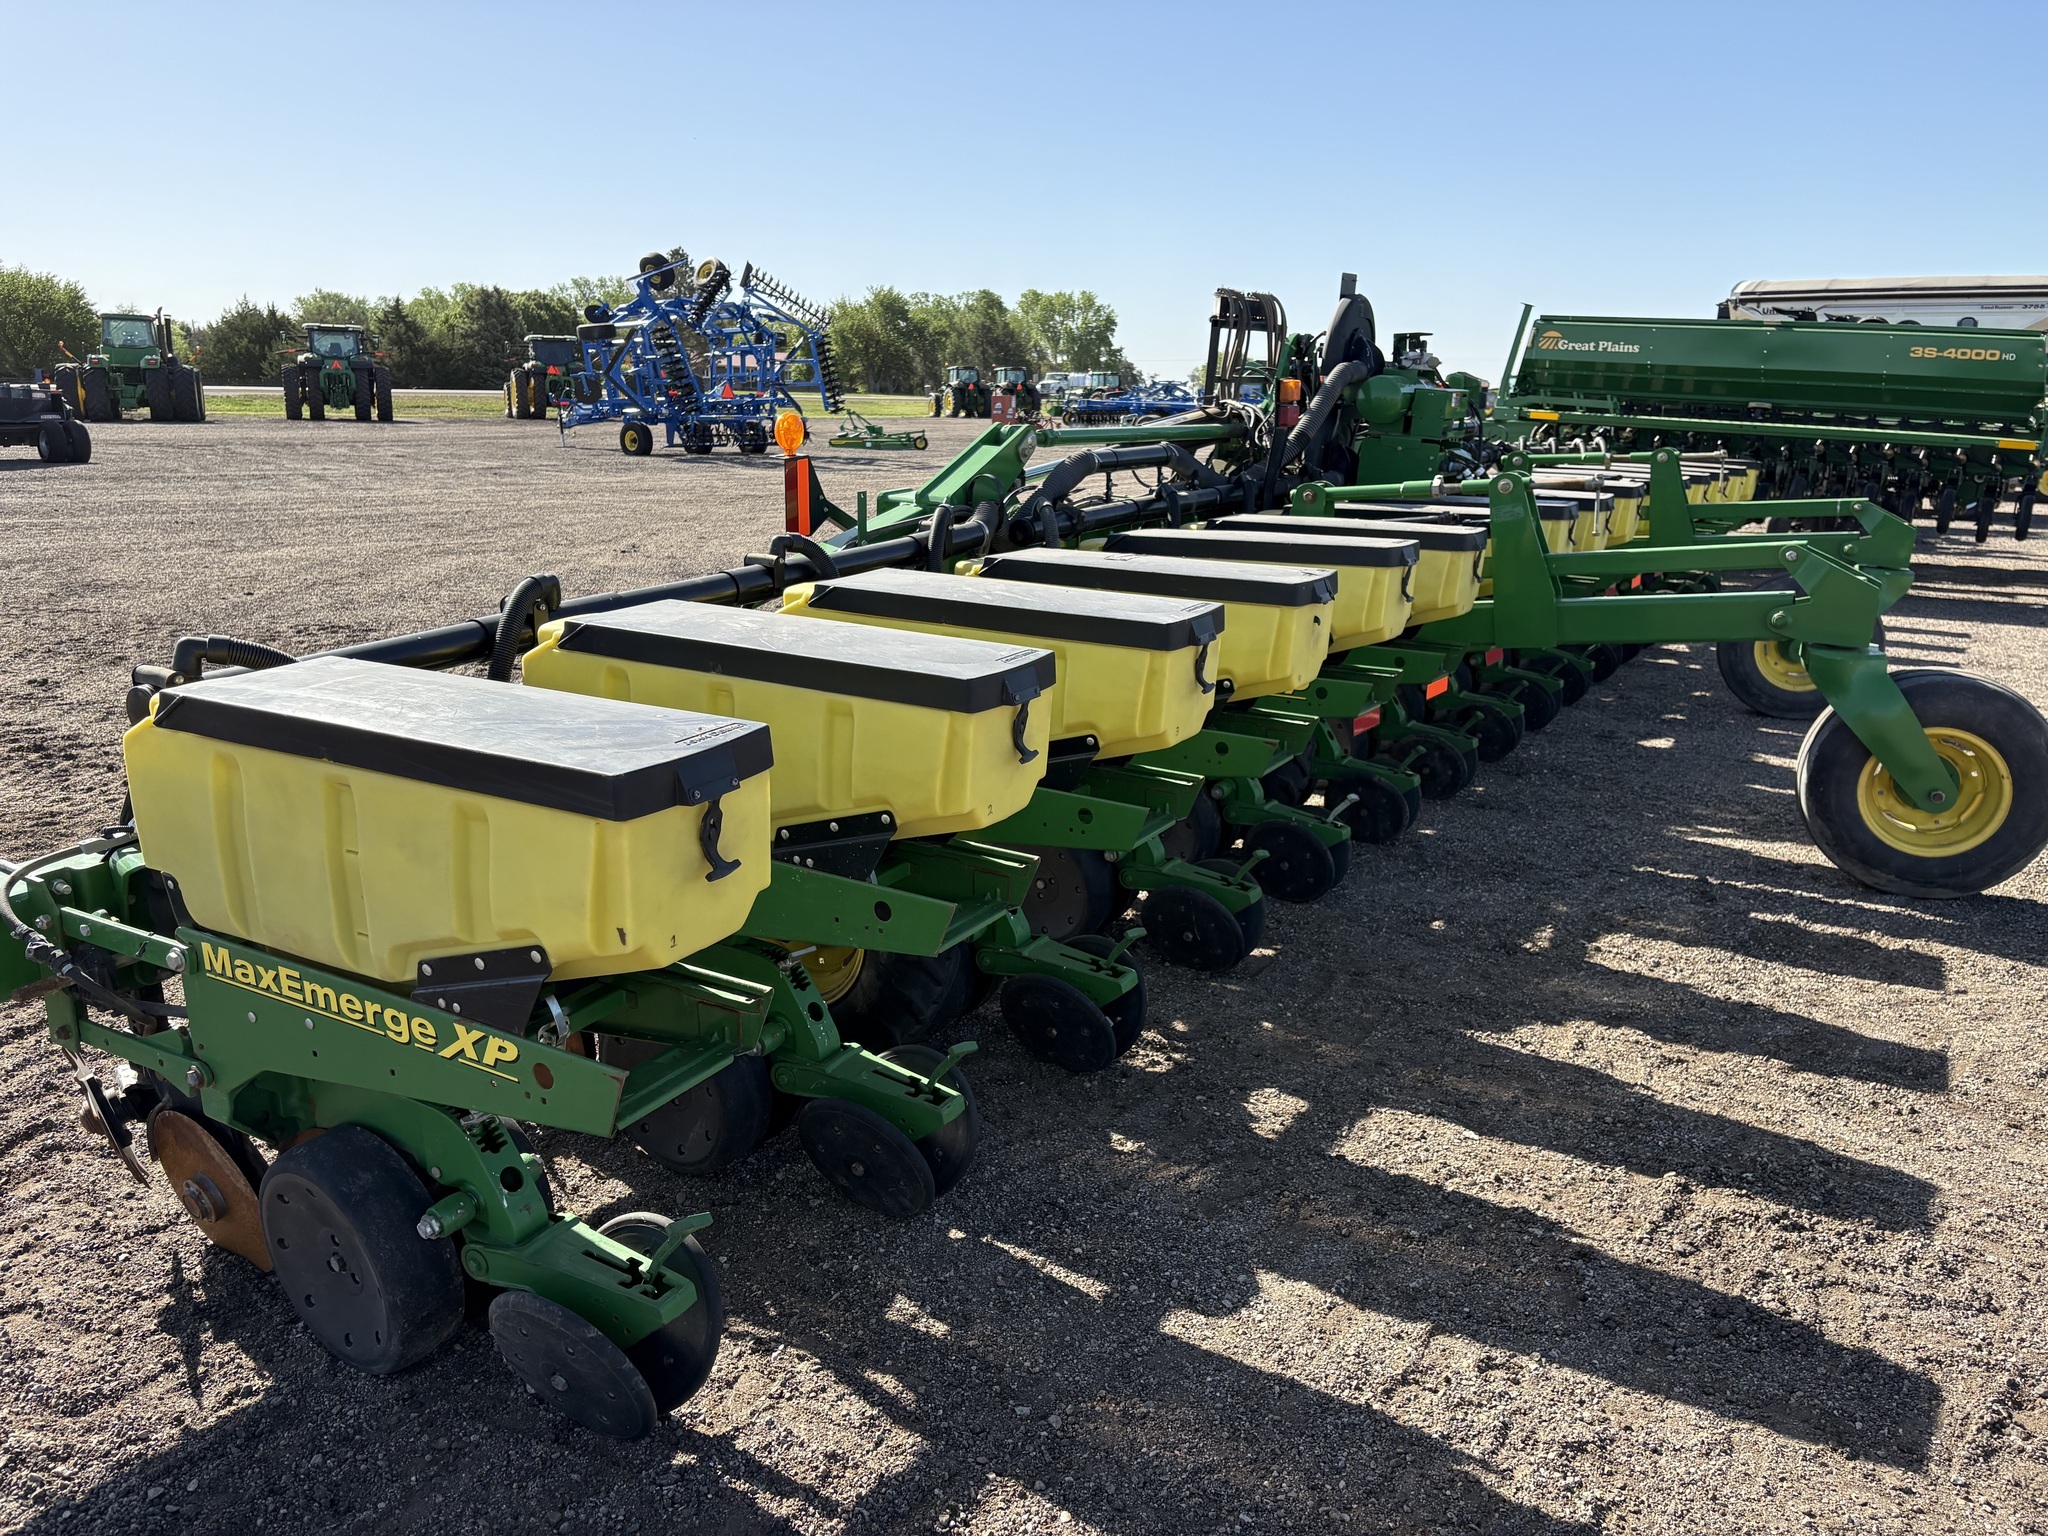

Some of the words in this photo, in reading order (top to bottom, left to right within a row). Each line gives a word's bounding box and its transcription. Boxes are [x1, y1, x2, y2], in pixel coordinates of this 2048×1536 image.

[1557, 339, 1596, 351] Great
[1598, 340, 1640, 353] Plains
[1909, 346, 2001, 361] 3S-4000
[2001, 353, 2016, 361] HD
[987, 804, 994, 816] 2
[670, 934, 678, 948] 1
[200, 941, 438, 1045] MaxEmerge
[437, 1022, 520, 1067] XP
